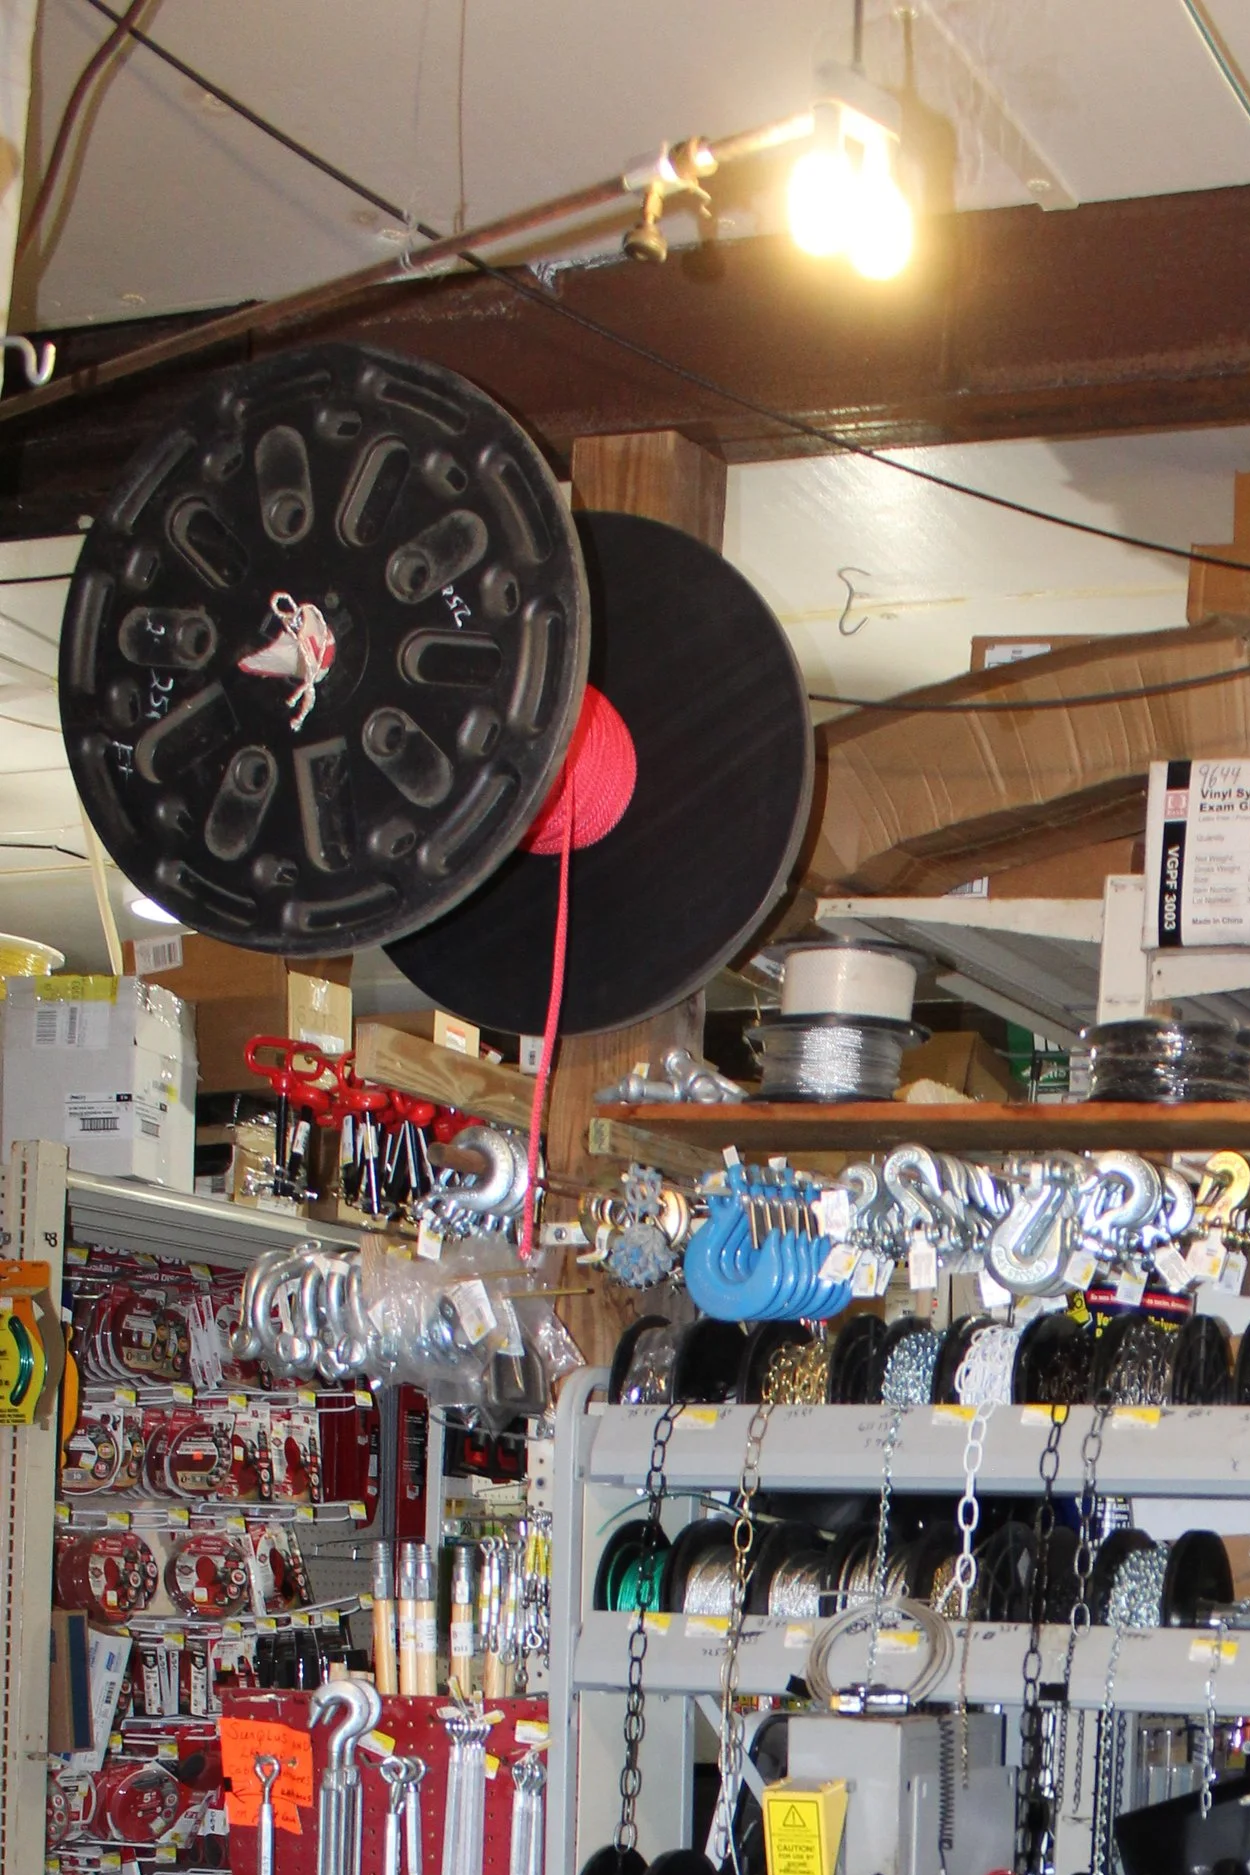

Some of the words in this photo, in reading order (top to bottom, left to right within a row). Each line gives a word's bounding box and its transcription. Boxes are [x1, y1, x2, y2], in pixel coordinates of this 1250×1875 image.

[1200, 788, 1232, 801] Vinyl
[1199, 803, 1235, 813] Exam
[1165, 845, 1181, 890] VGPF
[1164, 893, 1178, 932] 3003
[1192, 917, 1213, 925] Made
[1222, 916, 1244, 925] China
